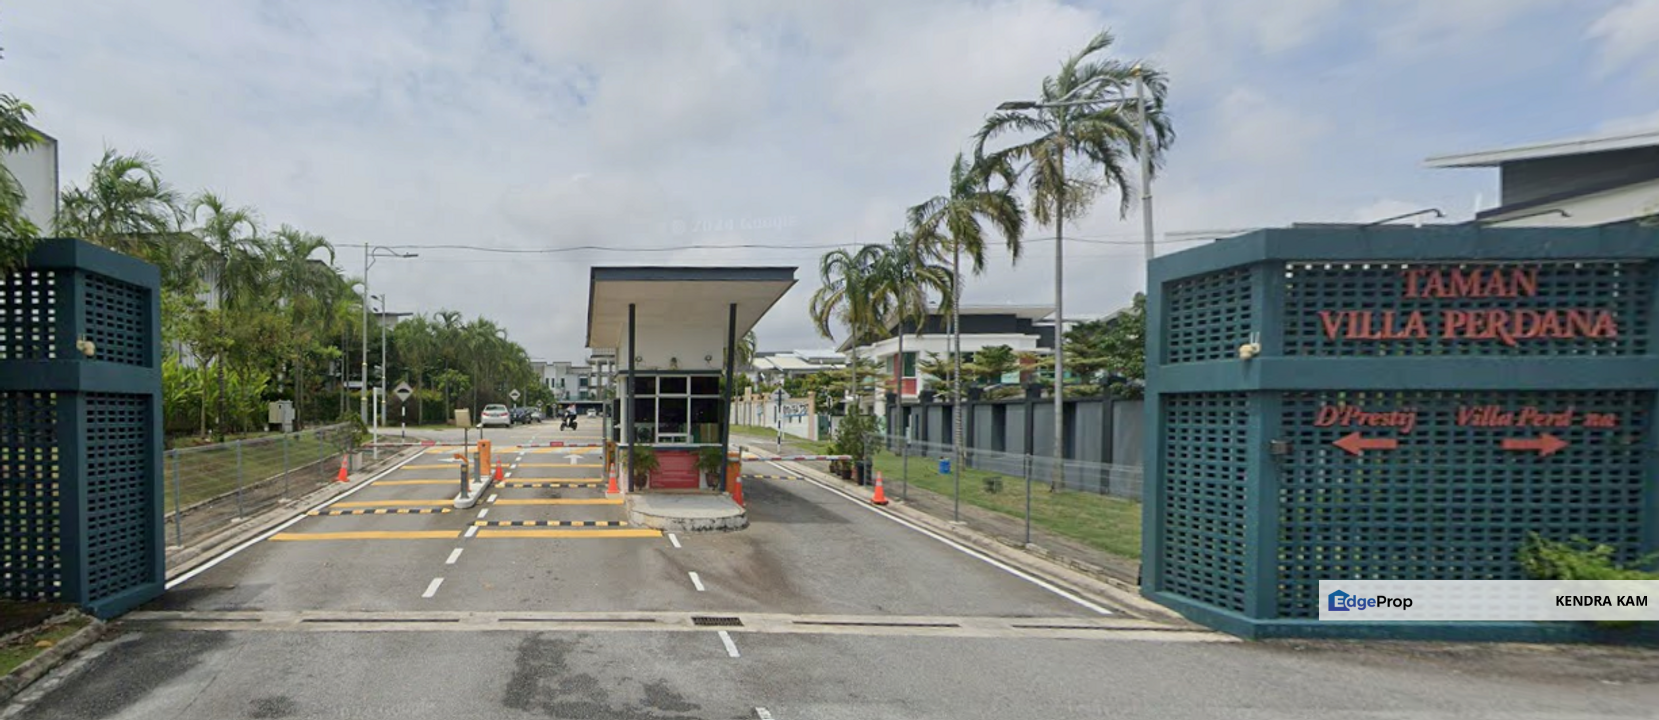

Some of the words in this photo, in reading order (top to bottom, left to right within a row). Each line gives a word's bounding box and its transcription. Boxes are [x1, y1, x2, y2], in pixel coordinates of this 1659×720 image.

[1401, 268, 1538, 298] TAMAN
[1319, 310, 1428, 341] VILLA
[1443, 309, 1618, 347] PERDANA
[1456, 405, 1514, 427] Villa
[1515, 406, 1618, 427] Perdna
